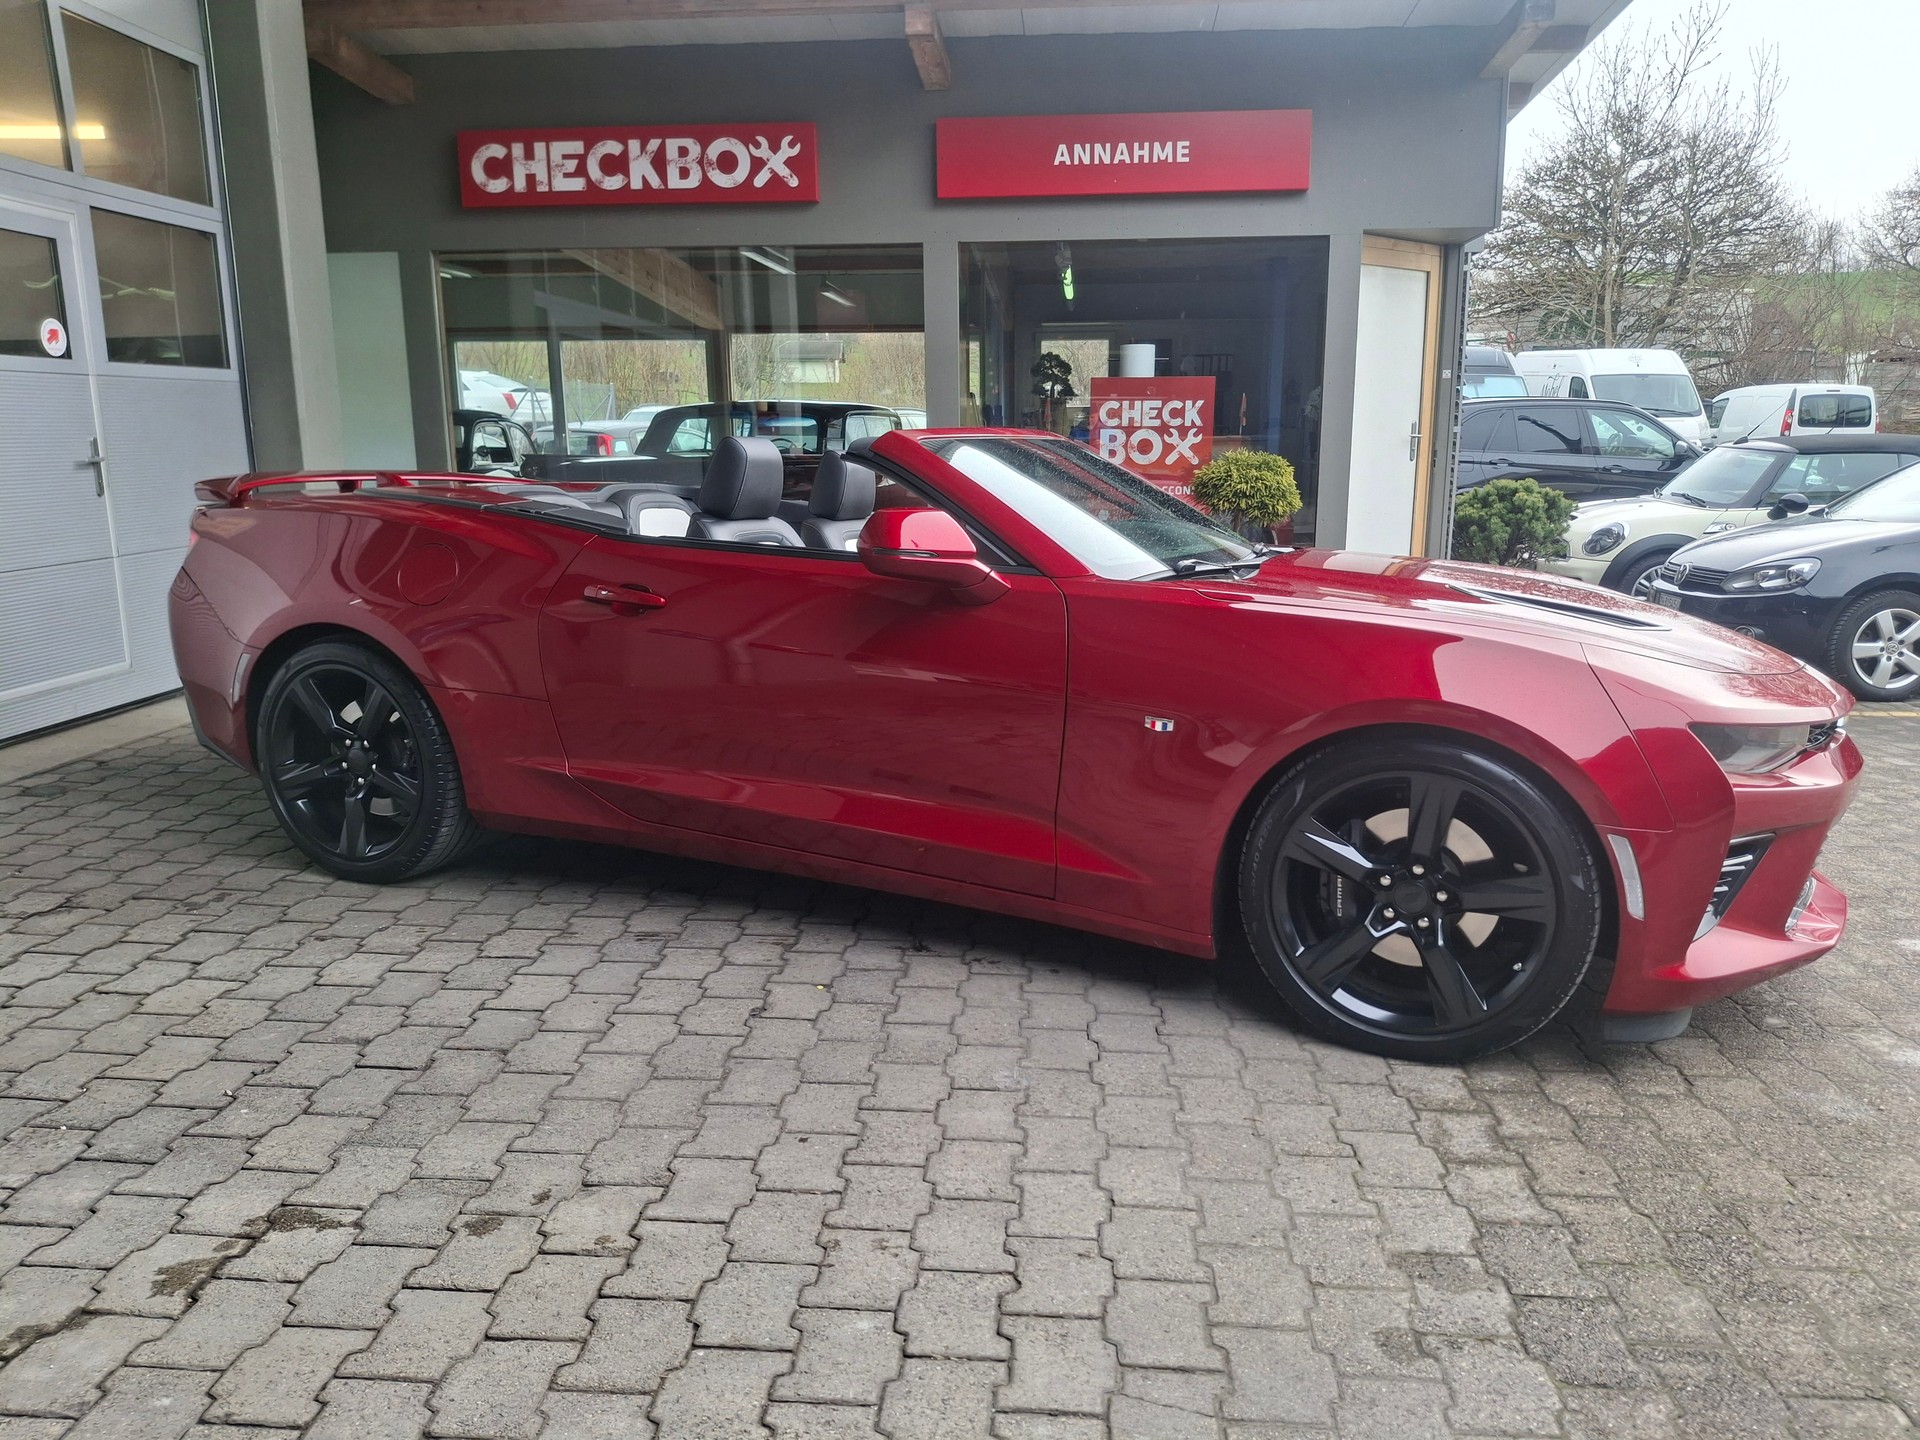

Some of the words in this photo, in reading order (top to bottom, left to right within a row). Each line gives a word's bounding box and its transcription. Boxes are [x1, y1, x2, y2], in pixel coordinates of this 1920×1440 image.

[470, 134, 801, 194] CHECKBOX
[1053, 141, 1190, 165] ANNAHME
[1098, 400, 1204, 427] CHECK
[1099, 428, 1203, 465] BOX
